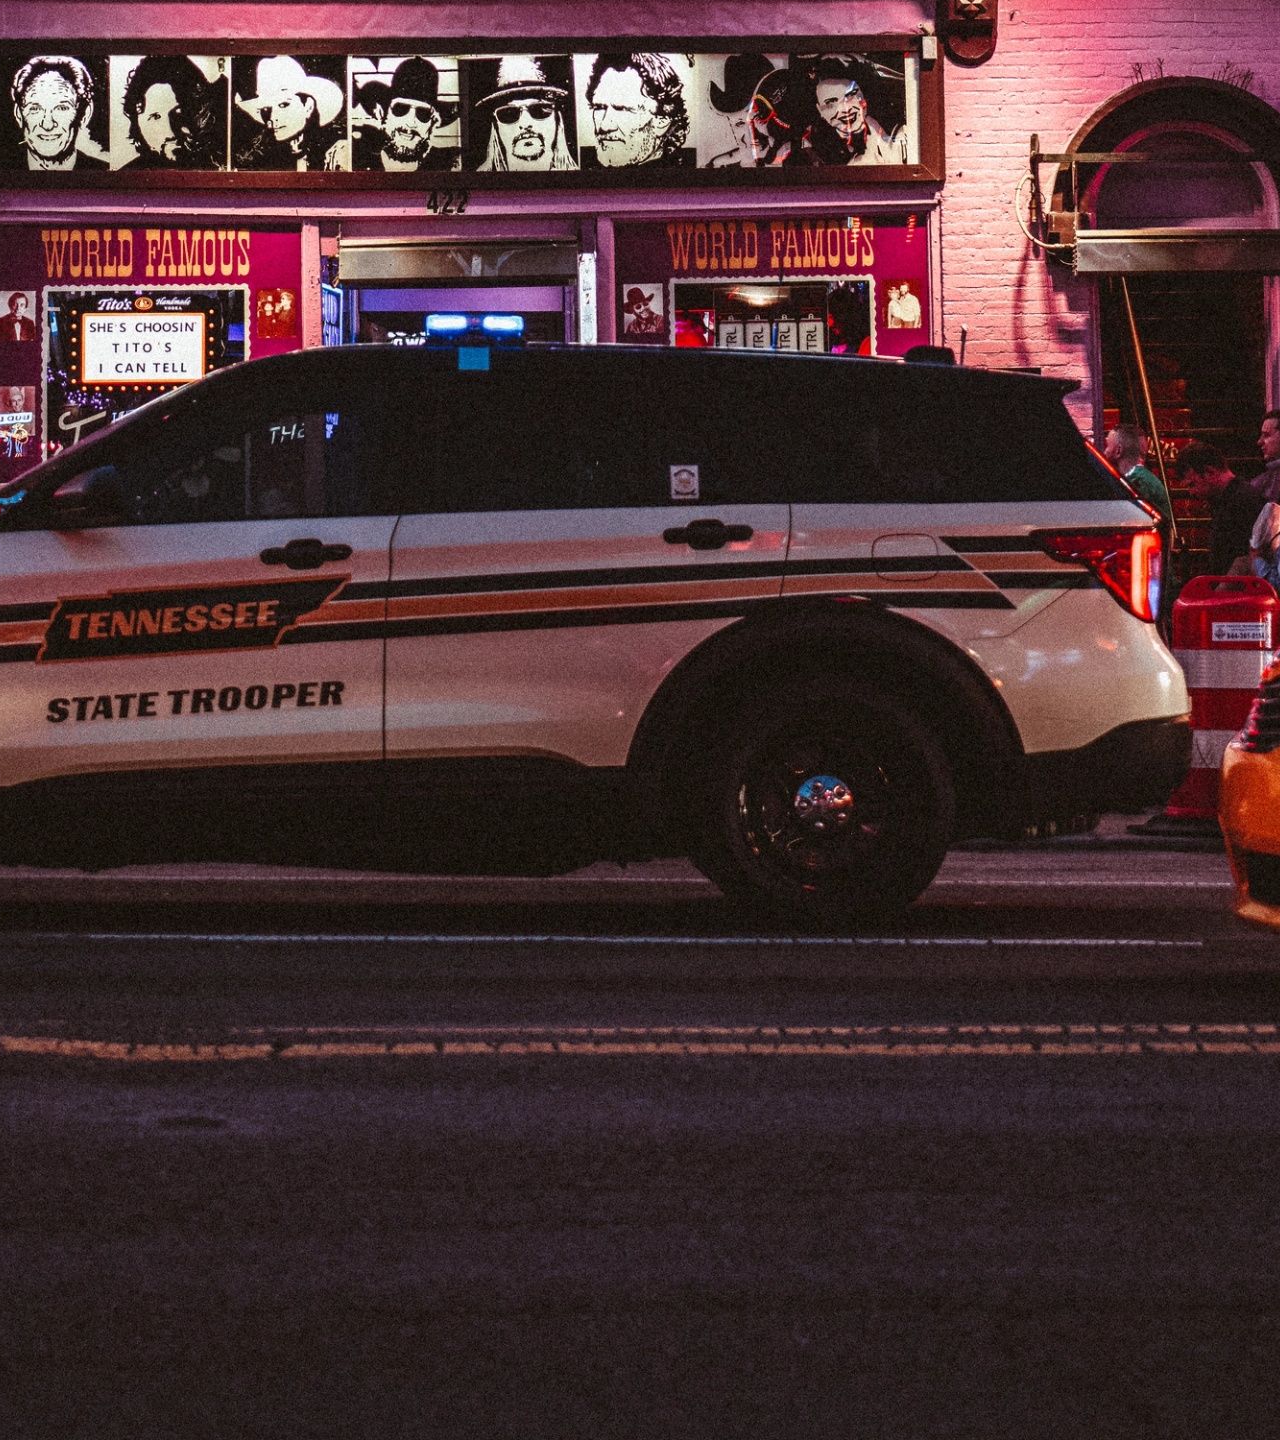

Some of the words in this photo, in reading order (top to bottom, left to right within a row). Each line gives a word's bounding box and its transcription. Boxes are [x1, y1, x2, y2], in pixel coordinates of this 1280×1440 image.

[426, 190, 470, 214] 422
[40, 229, 134, 279] WORLD
[144, 228, 251, 278] FAMOUS
[667, 220, 759, 271] WORLD
[769, 220, 875, 268] FAMOUS
[89, 322, 127, 333] SHE'S
[98, 363, 104, 374] I
[114, 362, 147, 374] CAN
[152, 362, 188, 374] TELL
[65, 598, 282, 642] TENNESSEE
[45, 690, 160, 725] STATE
[167, 680, 346, 716] TROOPER
